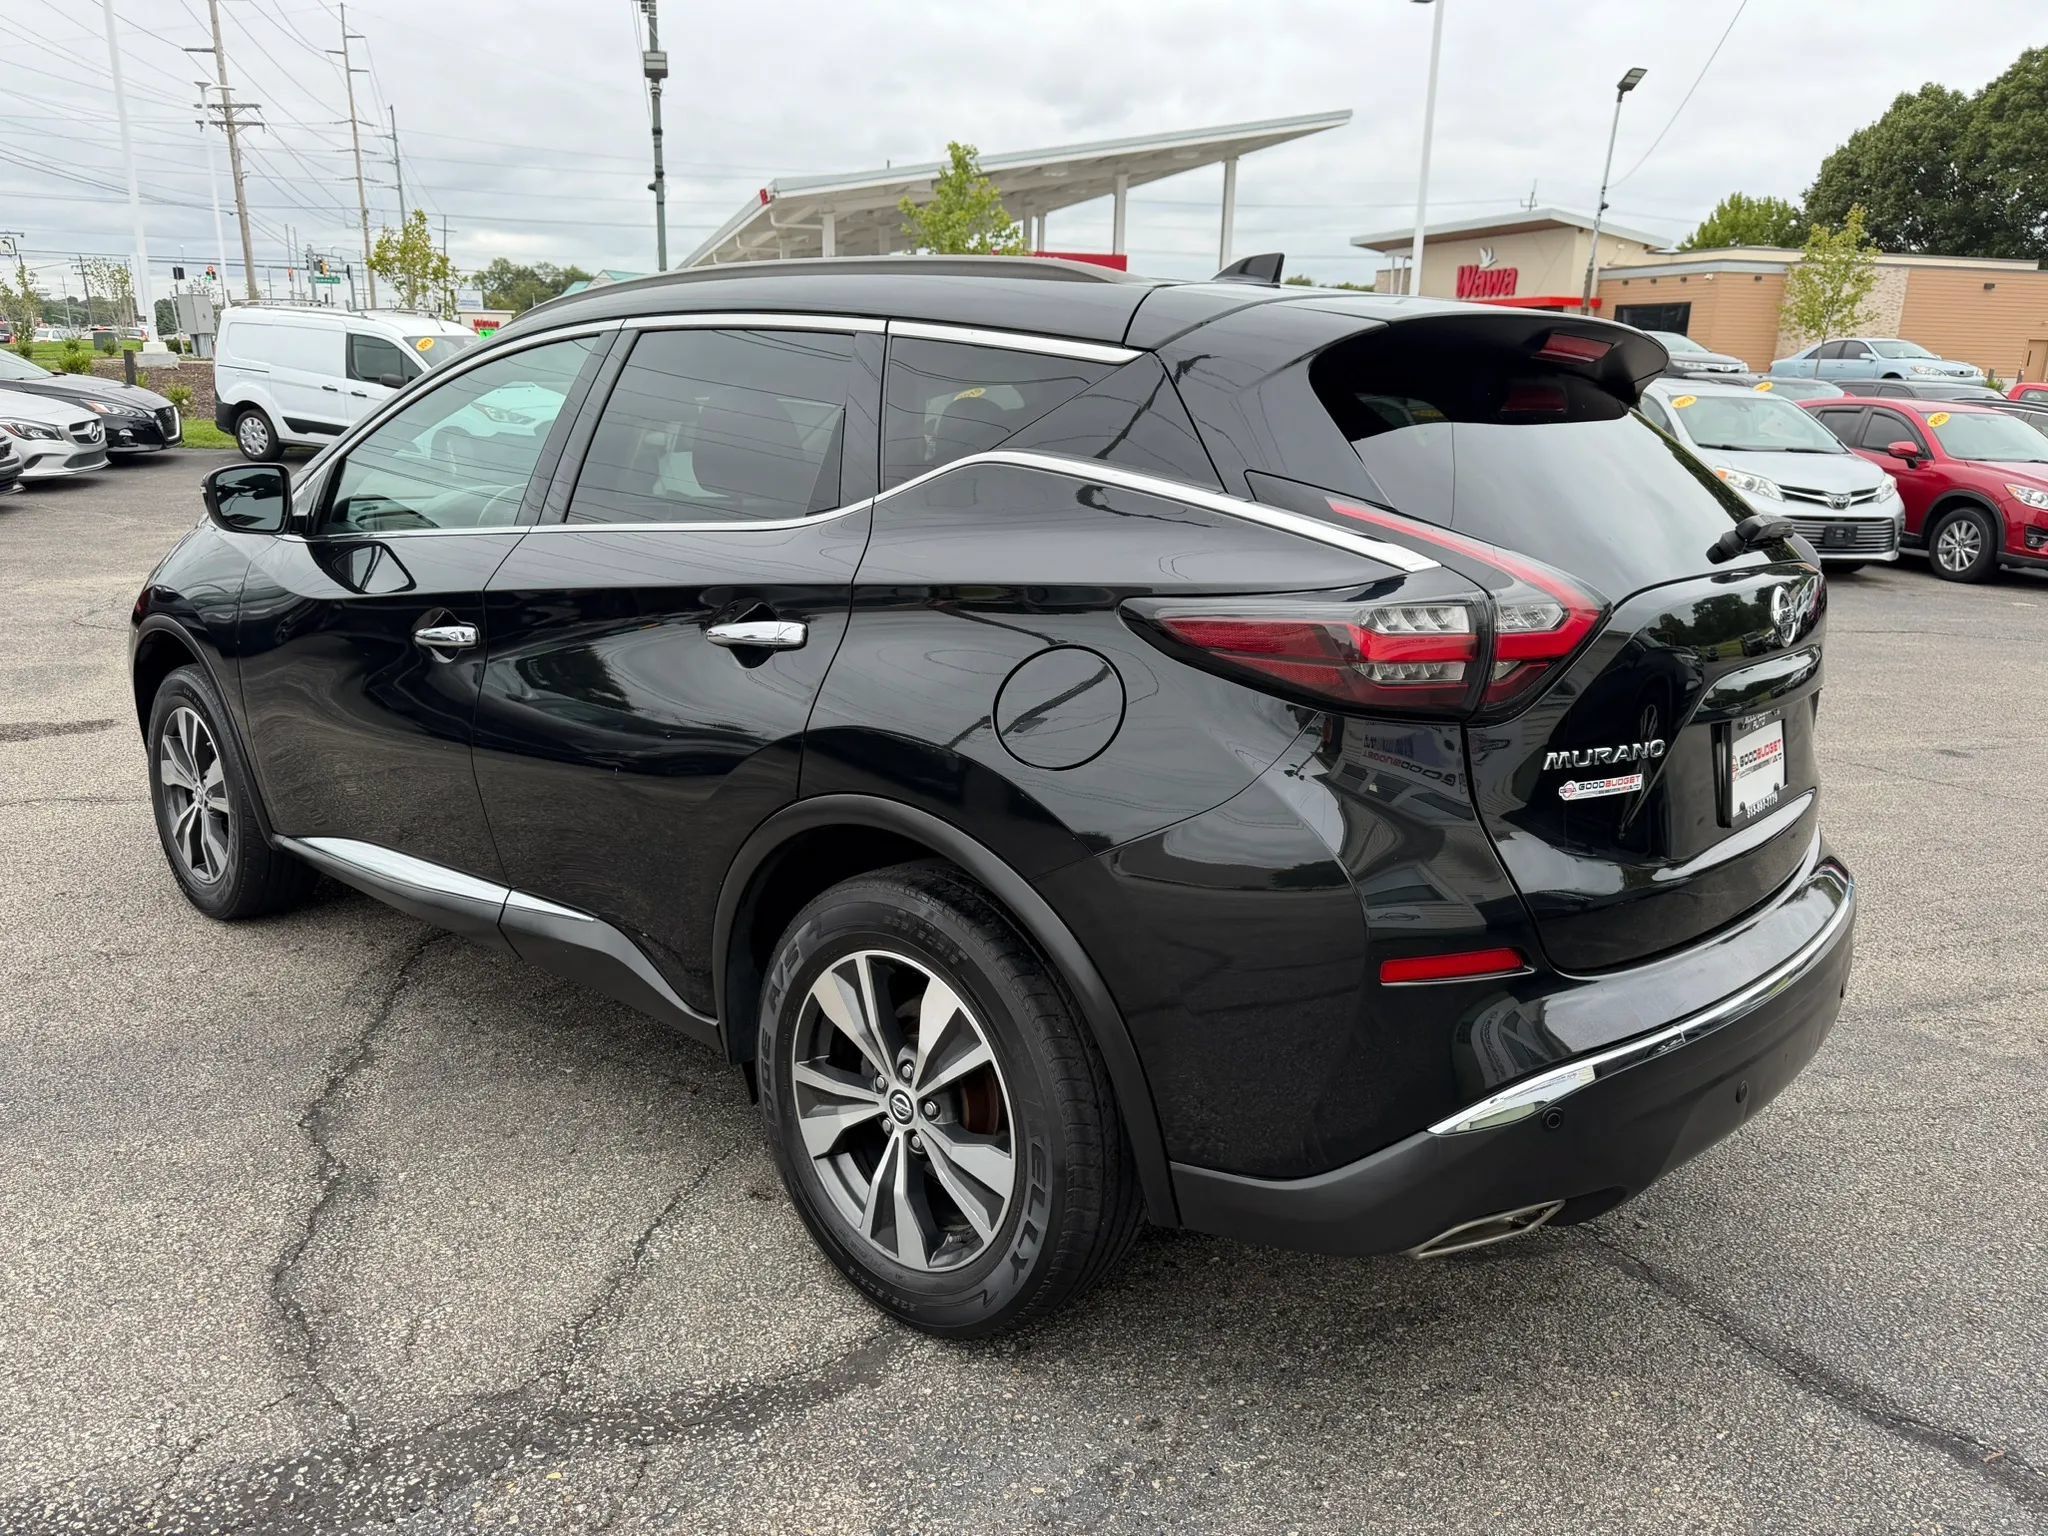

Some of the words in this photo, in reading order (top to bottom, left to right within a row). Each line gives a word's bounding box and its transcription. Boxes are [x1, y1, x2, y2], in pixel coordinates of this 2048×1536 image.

[1456, 264, 1518, 299] Wawa
[1543, 739, 1666, 771] MURANO
[1578, 775, 1641, 791] GOODBUDGET
